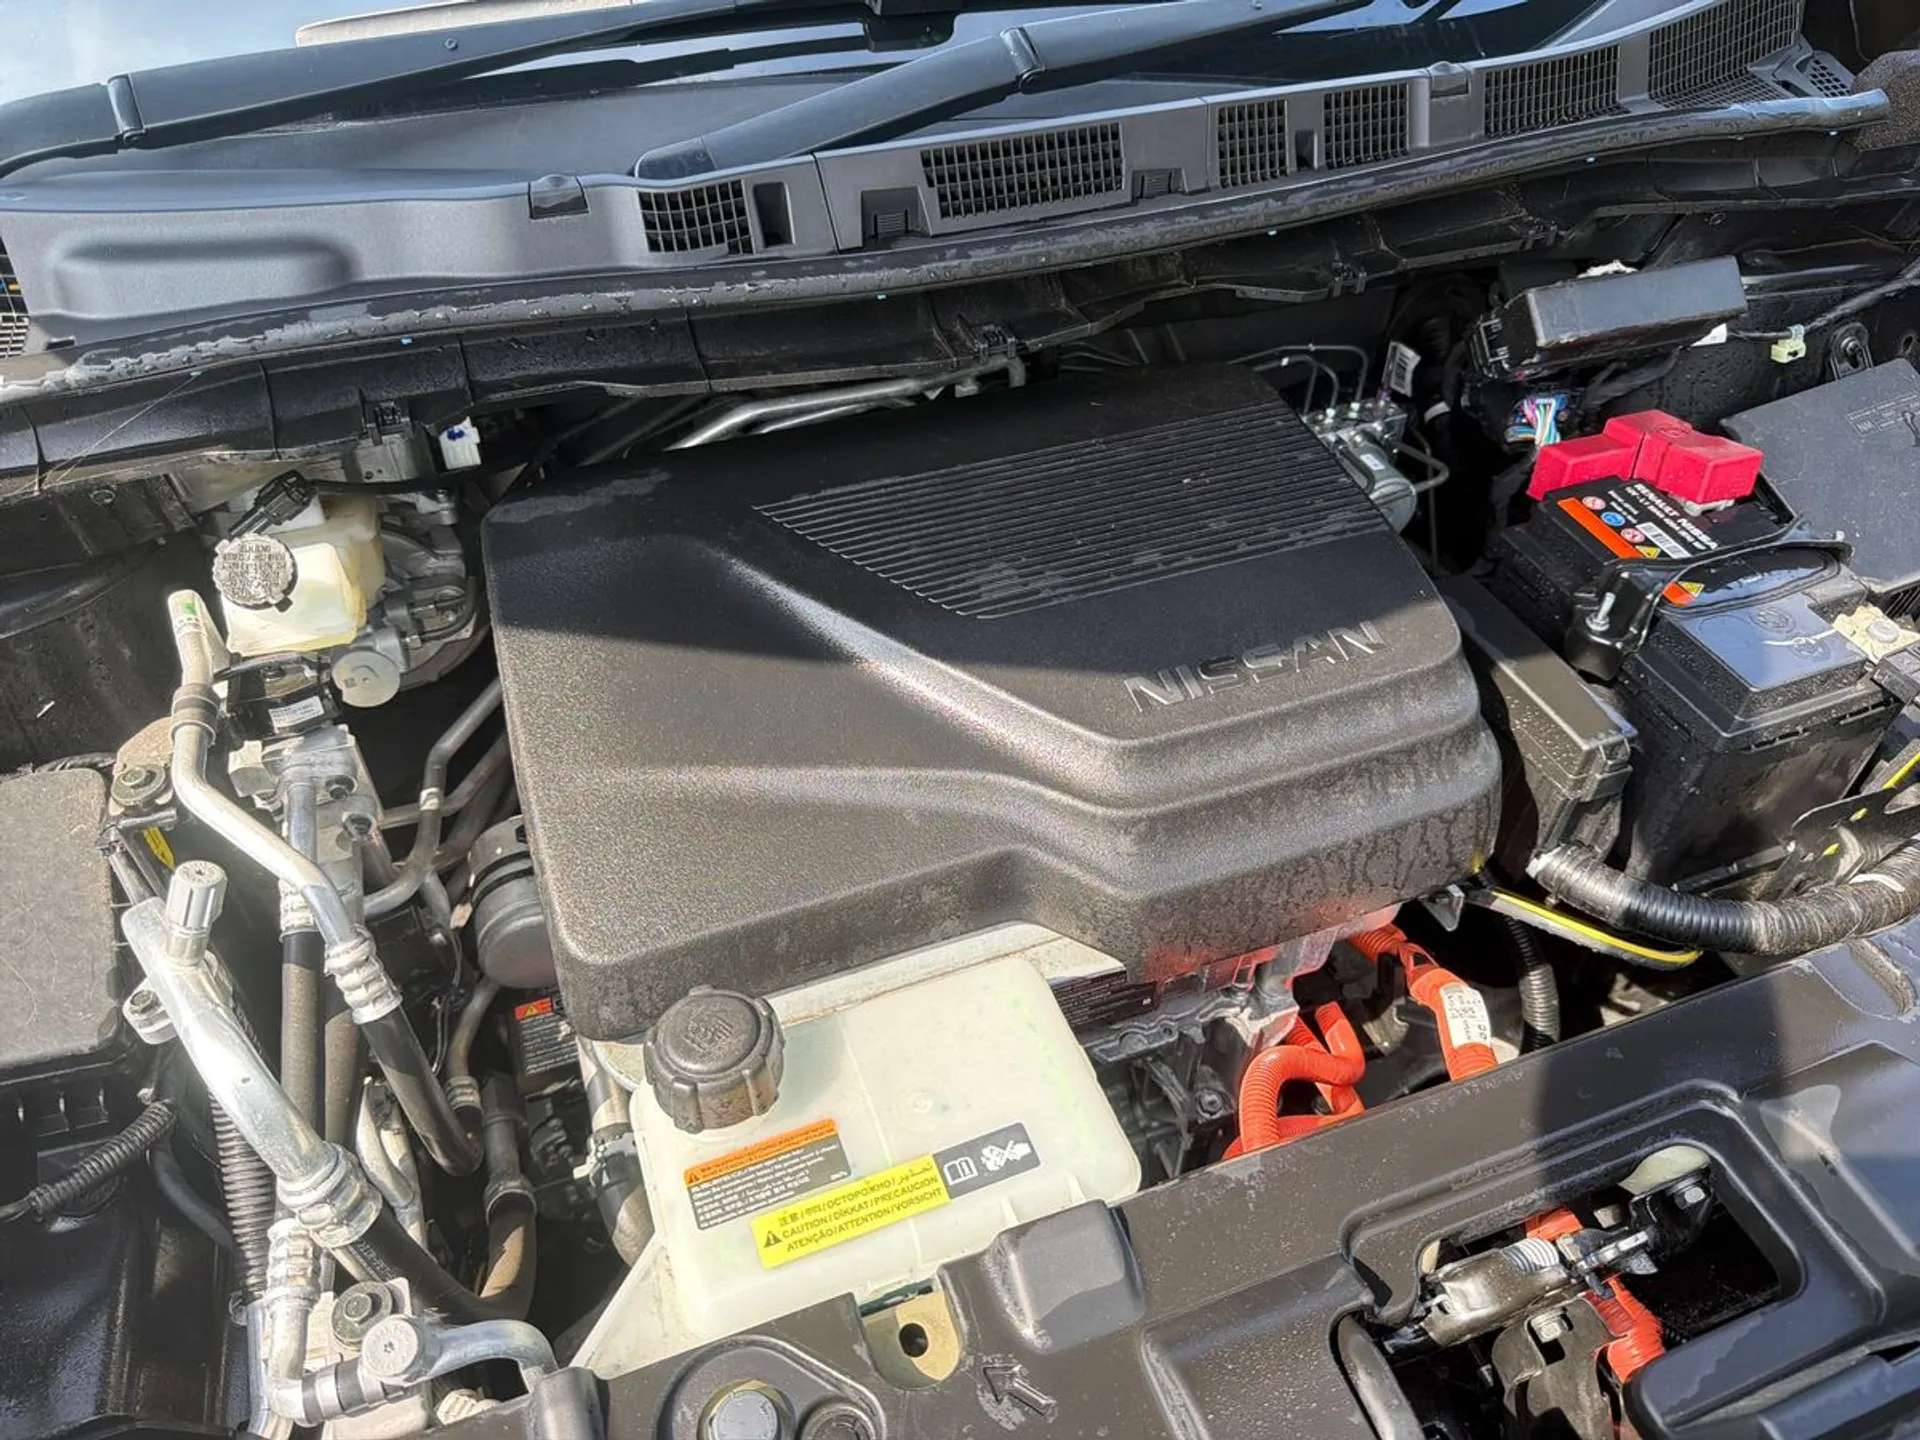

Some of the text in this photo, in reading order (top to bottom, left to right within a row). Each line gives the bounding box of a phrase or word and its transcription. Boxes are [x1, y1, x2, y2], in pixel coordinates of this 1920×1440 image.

[1634, 483, 1680, 517] RENAULT
[1677, 517, 1718, 550] NISSA
[1123, 620, 1395, 713] NISSAN
